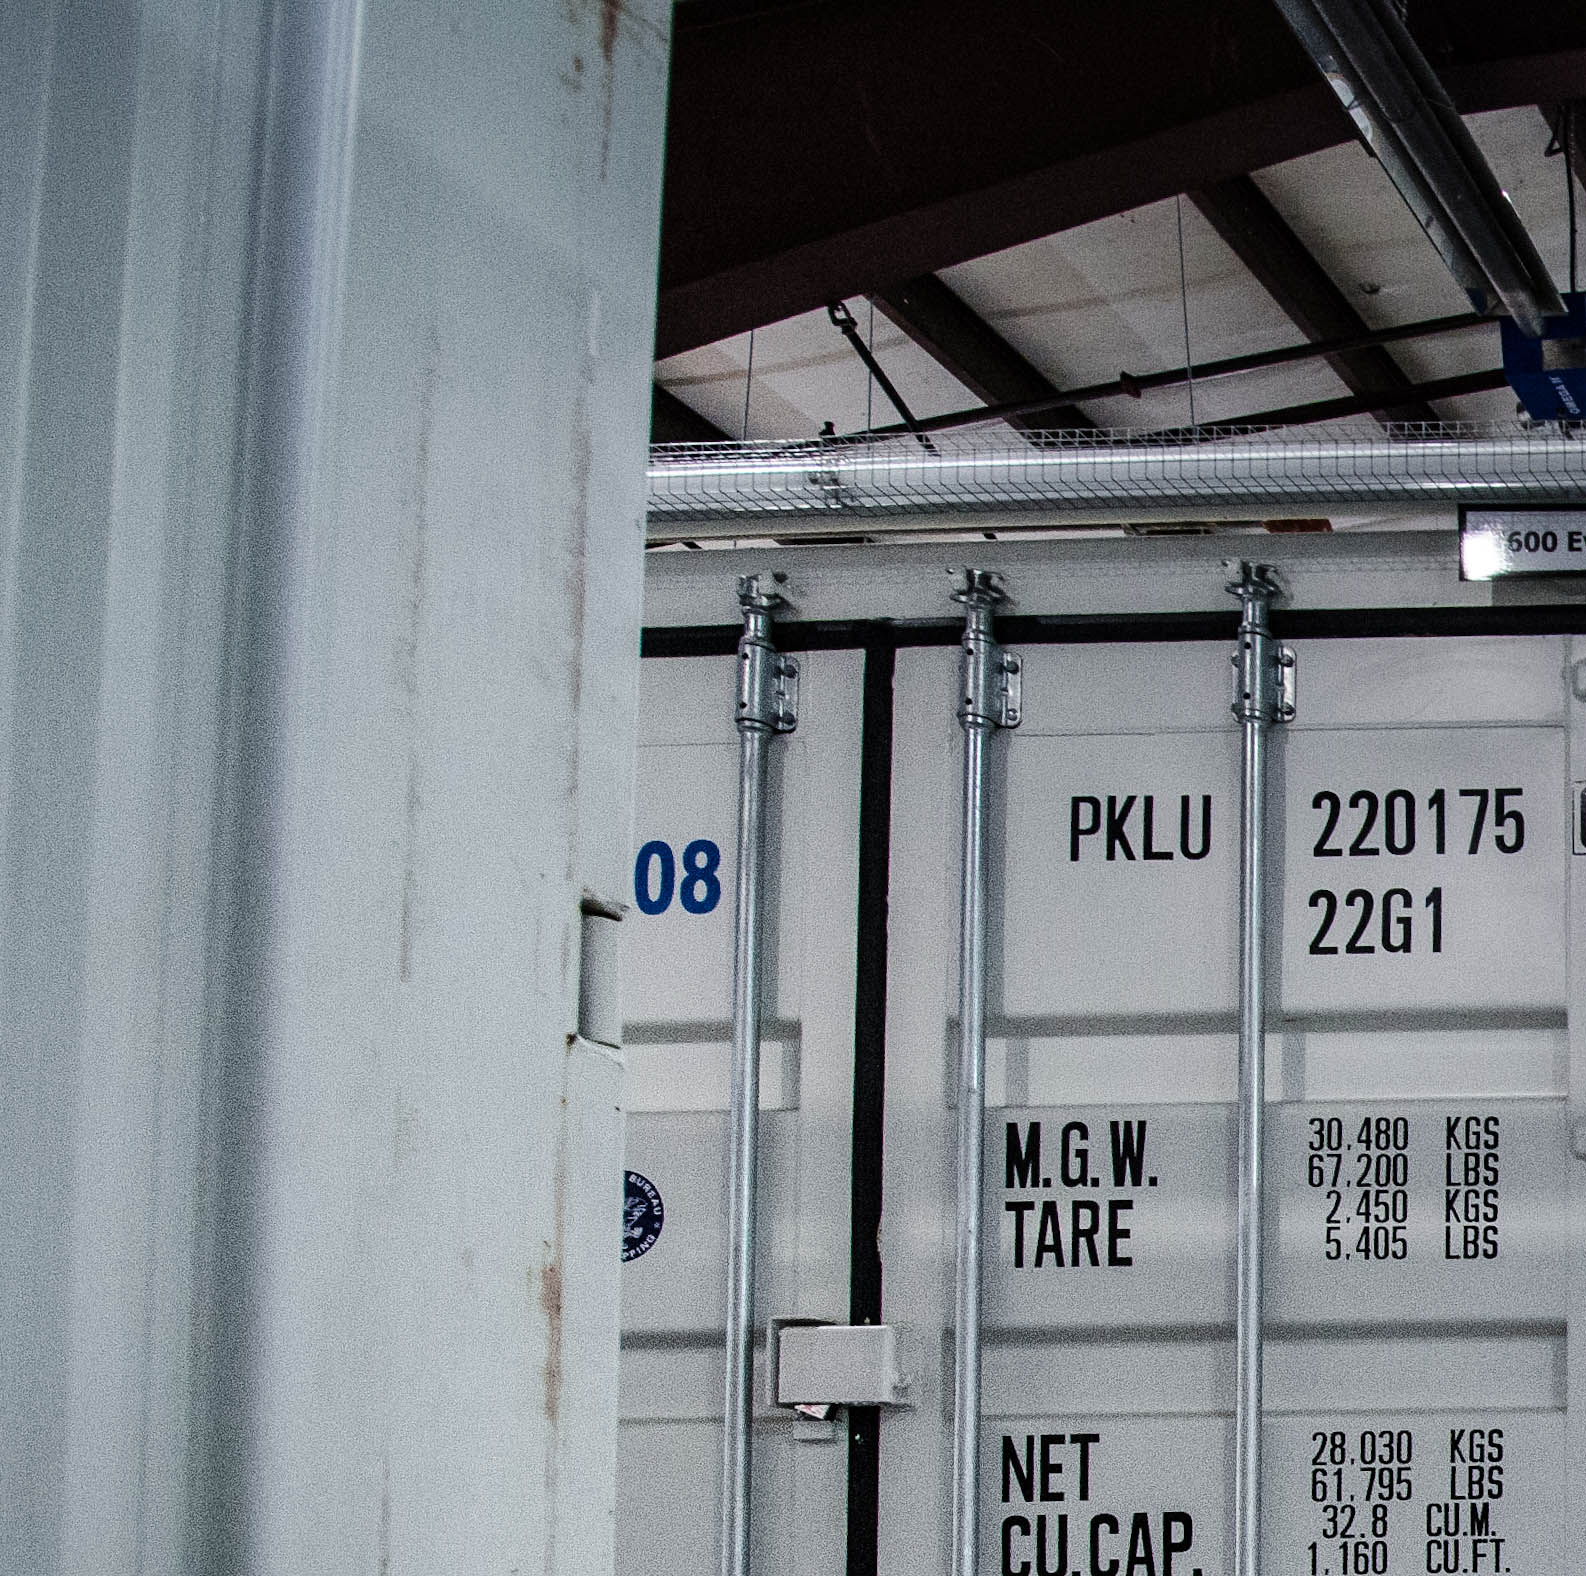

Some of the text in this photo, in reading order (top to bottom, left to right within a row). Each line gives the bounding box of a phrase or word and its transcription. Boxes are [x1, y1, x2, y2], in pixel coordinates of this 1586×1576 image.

[1508, 530, 1558, 553] 600
[1070, 794, 1212, 862] PKLU
[1311, 787, 1525, 858] 220175
[634, 839, 722, 916] 08
[1308, 886, 1442, 956] 22G1
[1445, 1116, 1500, 1152] KGS
[1004, 1119, 1158, 1189] M.G.W.
[1445, 1152, 1500, 1188] LBS
[629, 1174, 662, 1216] BUREAU
[1445, 1188, 1500, 1224] KGS
[1004, 1199, 1134, 1269] TARE
[1444, 1225, 1499, 1261] LBS
[1449, 1428, 1504, 1464] KGS
[1001, 1433, 1101, 1503] NET
[1450, 1465, 1504, 1501] LBS
[1322, 1501, 1497, 1539] 32.8 CU.M.
[1426, 1538, 1511, 1574] CU.FT.
